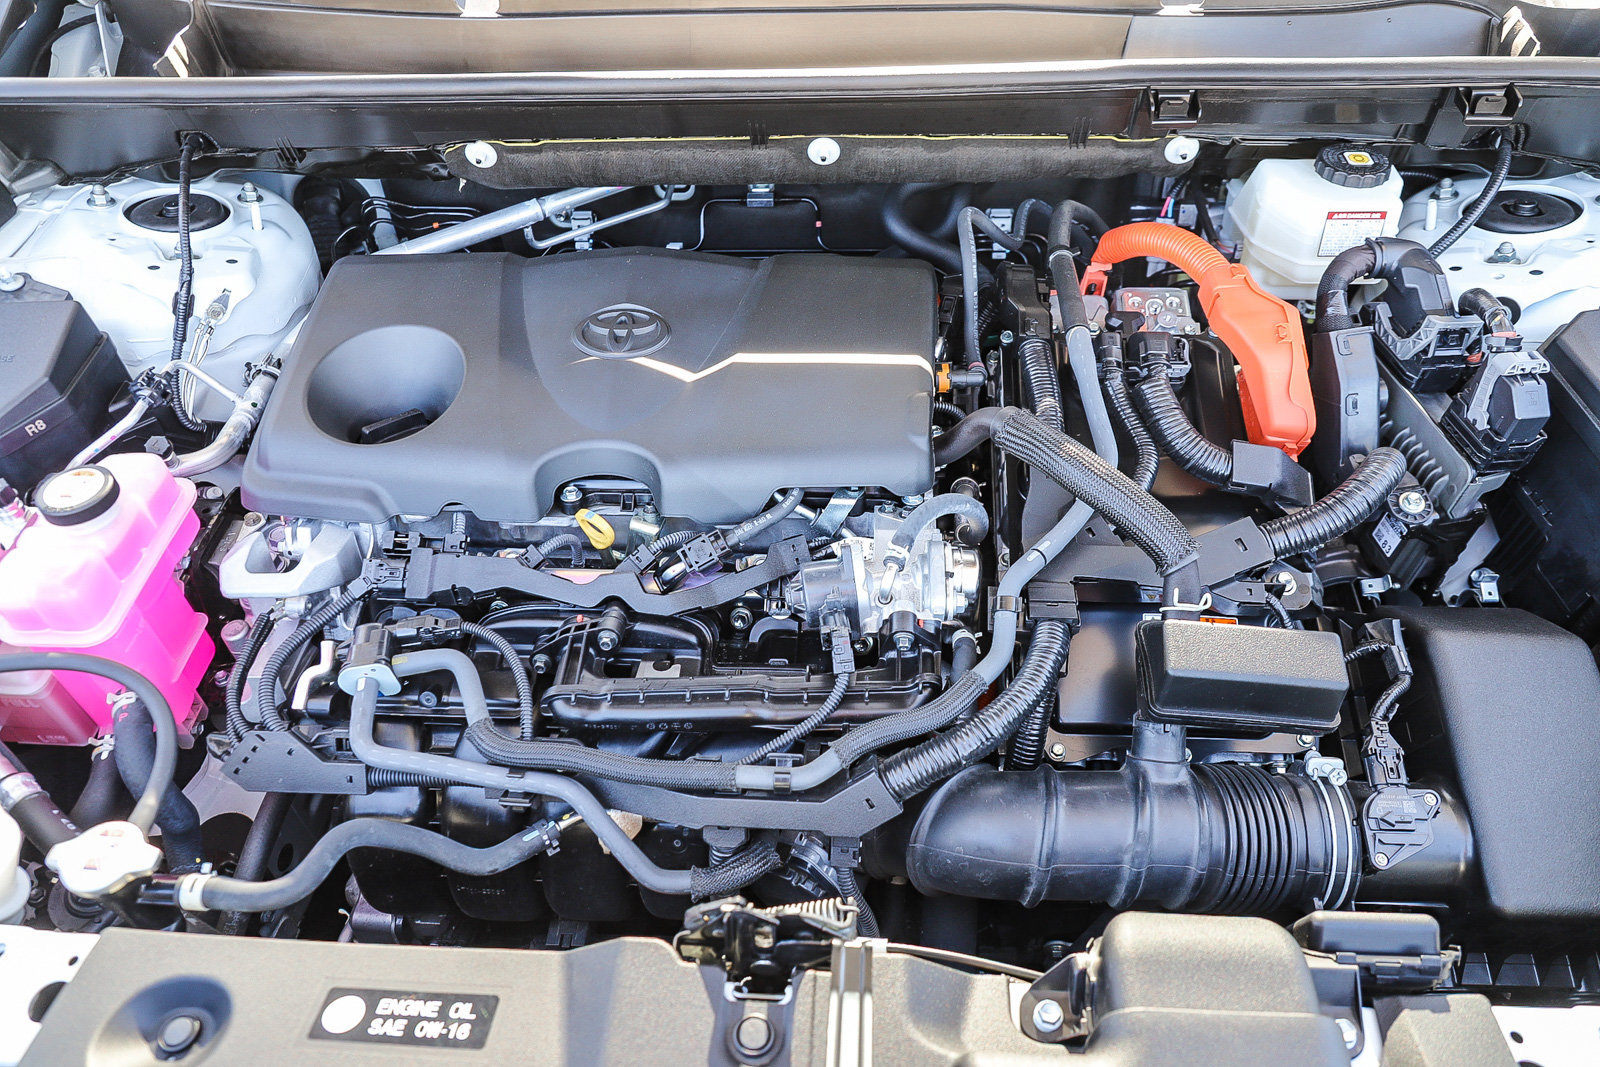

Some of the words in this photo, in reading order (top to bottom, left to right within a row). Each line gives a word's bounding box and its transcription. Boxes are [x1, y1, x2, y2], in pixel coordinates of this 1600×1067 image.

[24, 419, 47, 437] R8
[1381, 539, 1392, 554] 83
[375, 998, 442, 1017] ENGINE
[448, 1001, 476, 1020] OIL
[367, 1018, 408, 1037] SAE
[413, 1020, 472, 1041] 0W-16
